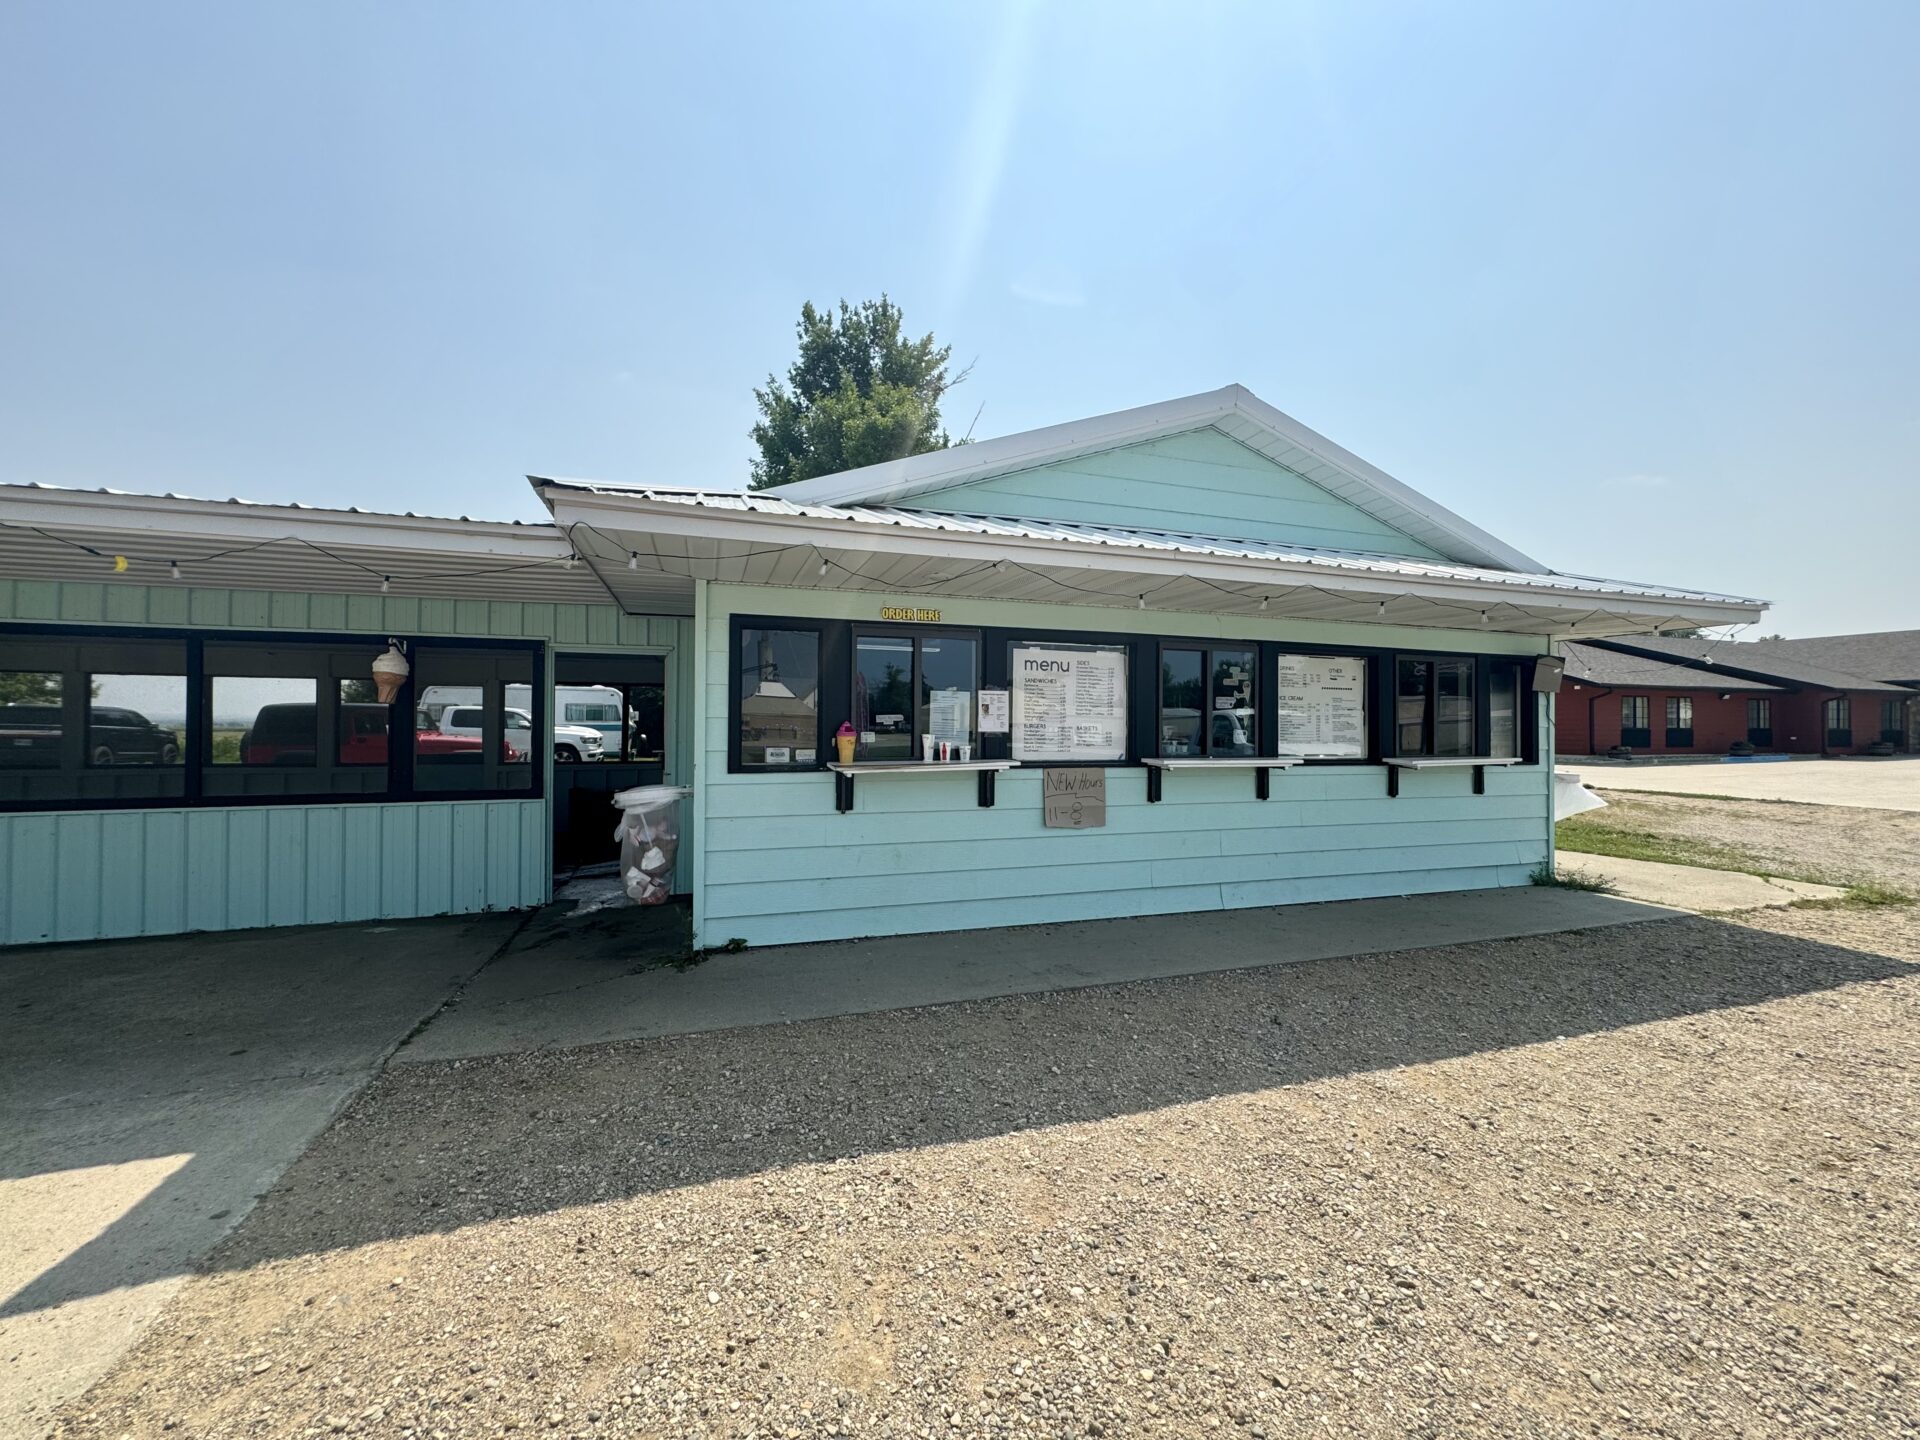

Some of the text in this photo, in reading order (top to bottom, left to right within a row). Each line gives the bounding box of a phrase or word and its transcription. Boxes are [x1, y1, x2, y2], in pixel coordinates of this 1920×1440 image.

[882, 607, 941, 622] ORDER HERE
[1024, 659, 1070, 672] menu
[1046, 771, 1103, 791] NEW Hours
